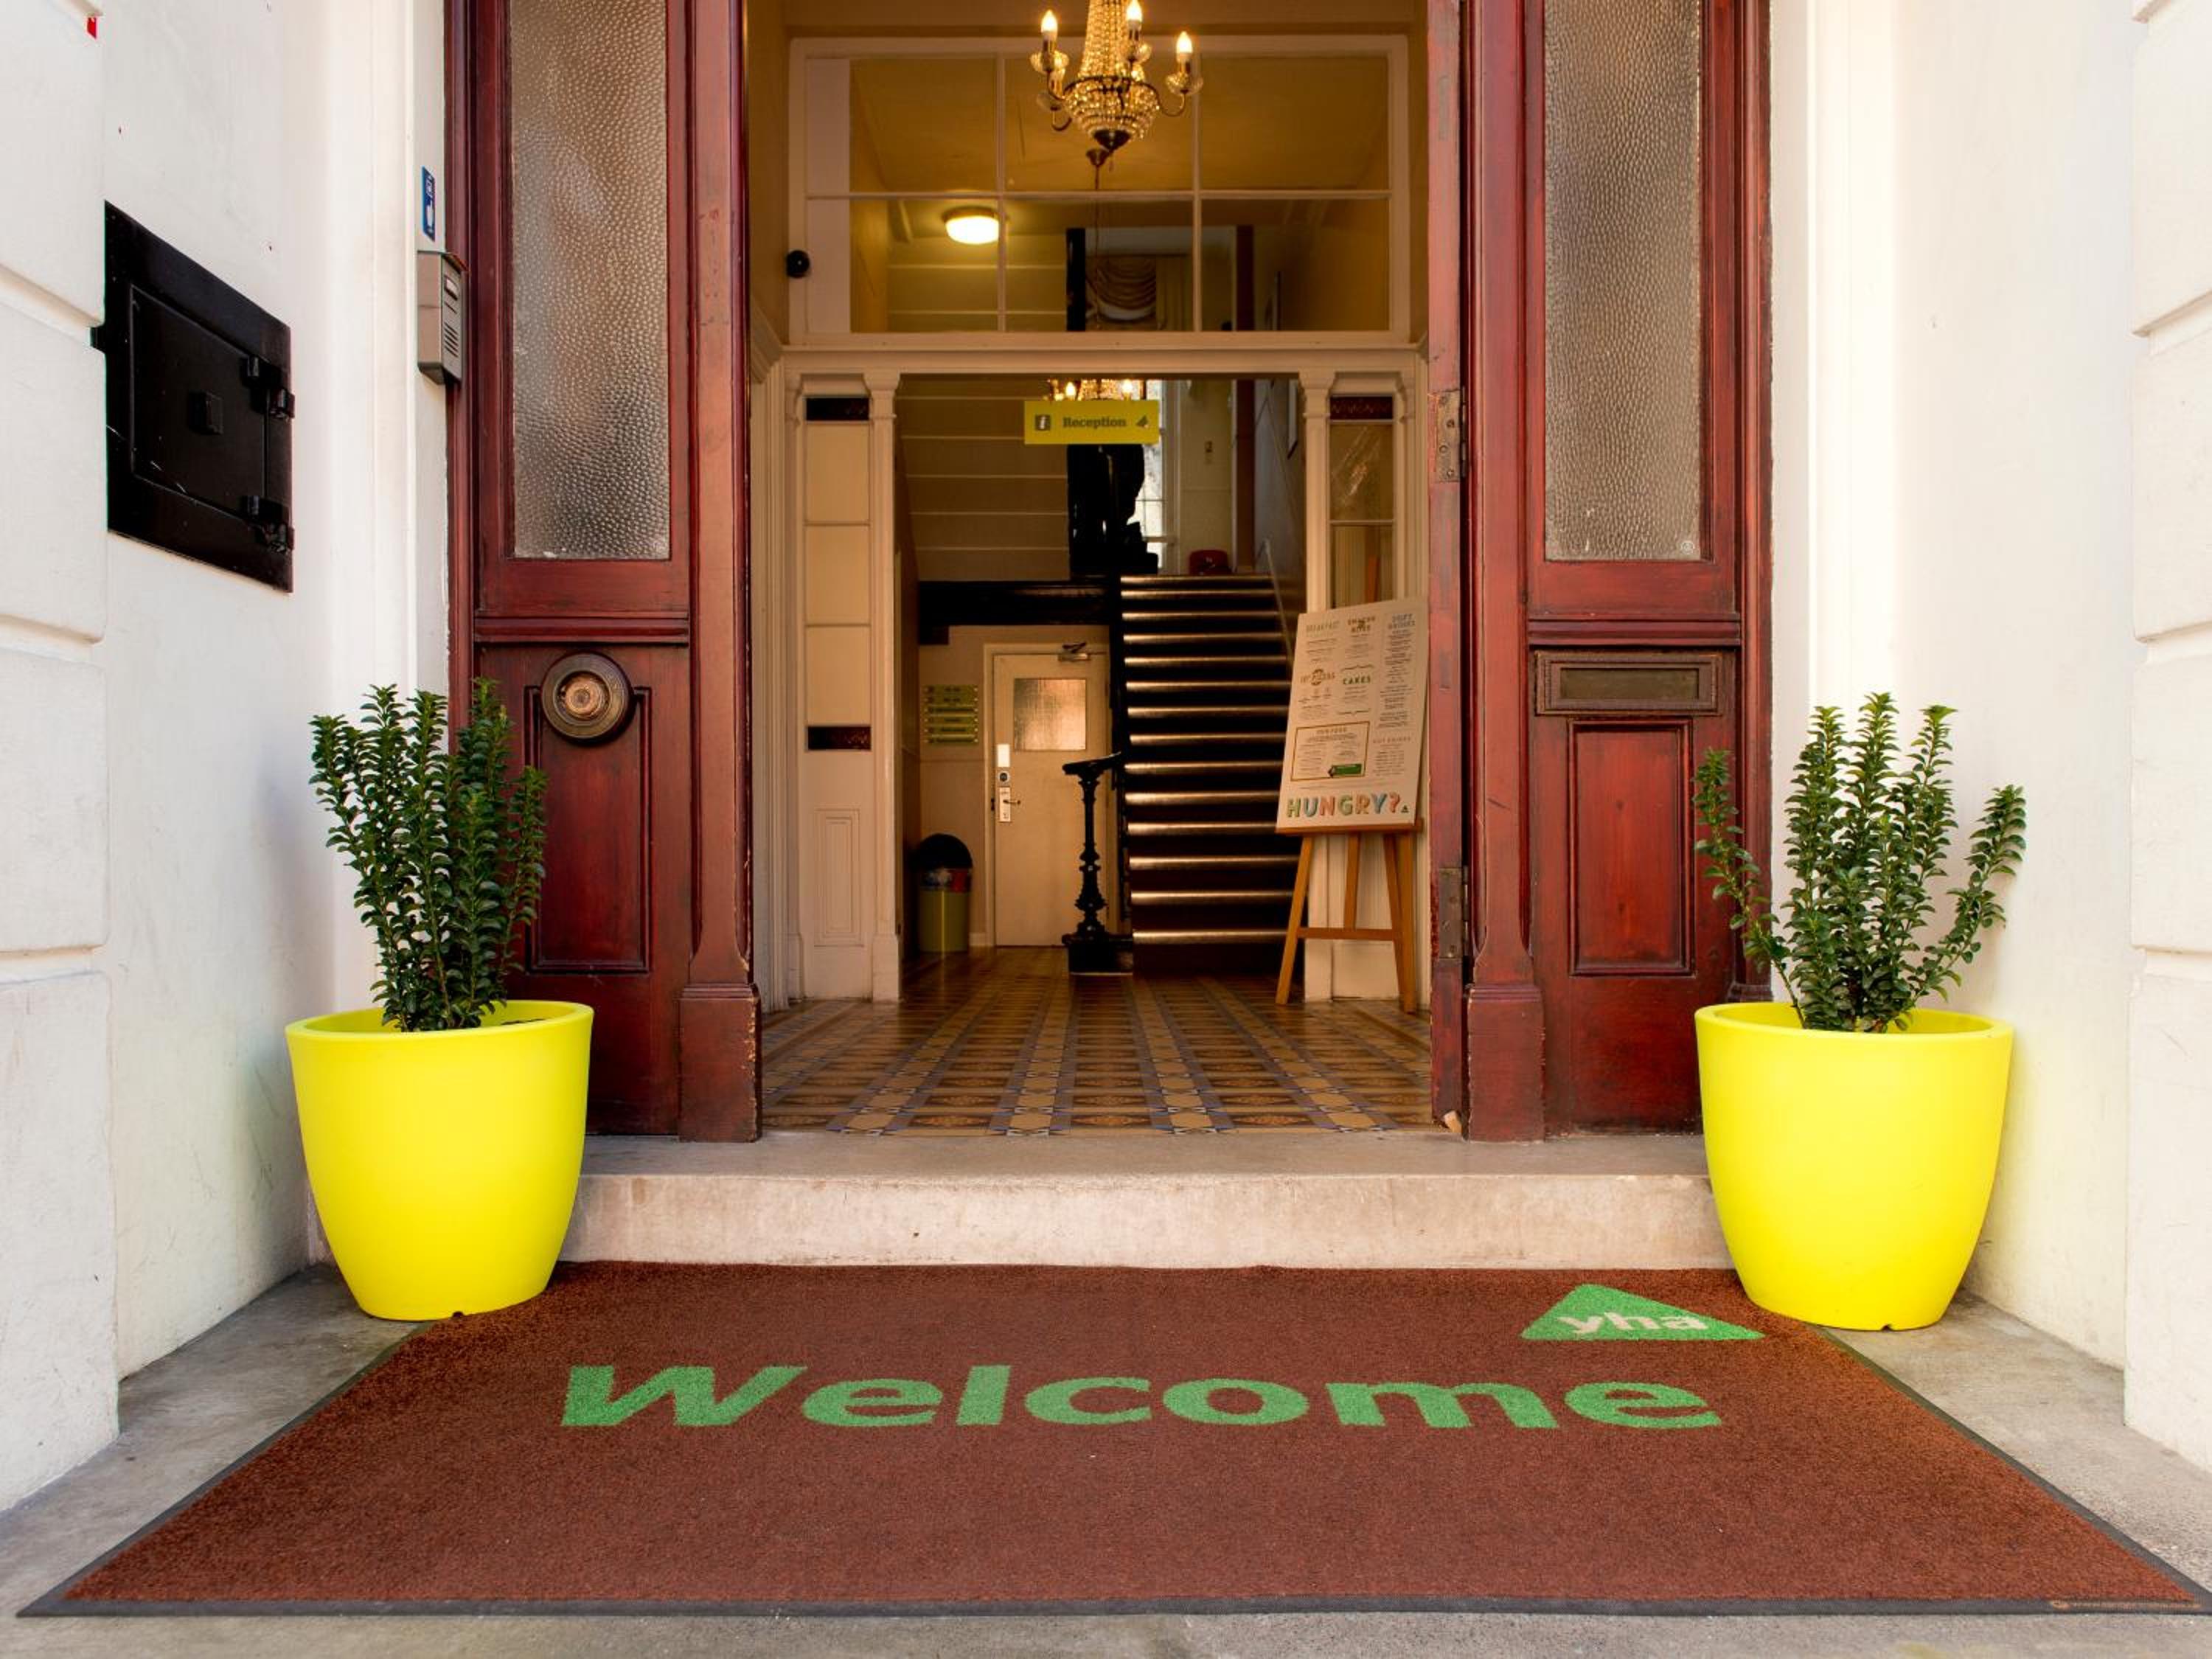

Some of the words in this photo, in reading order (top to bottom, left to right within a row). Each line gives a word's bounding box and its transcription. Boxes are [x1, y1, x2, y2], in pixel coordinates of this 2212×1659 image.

[1062, 417, 1127, 428] Reception
[1343, 675, 1371, 686] CAKES
[1287, 792, 1401, 818] HUNGRY?
[1557, 1312, 1709, 1335] yha
[564, 1365, 1717, 1427] Welcome
